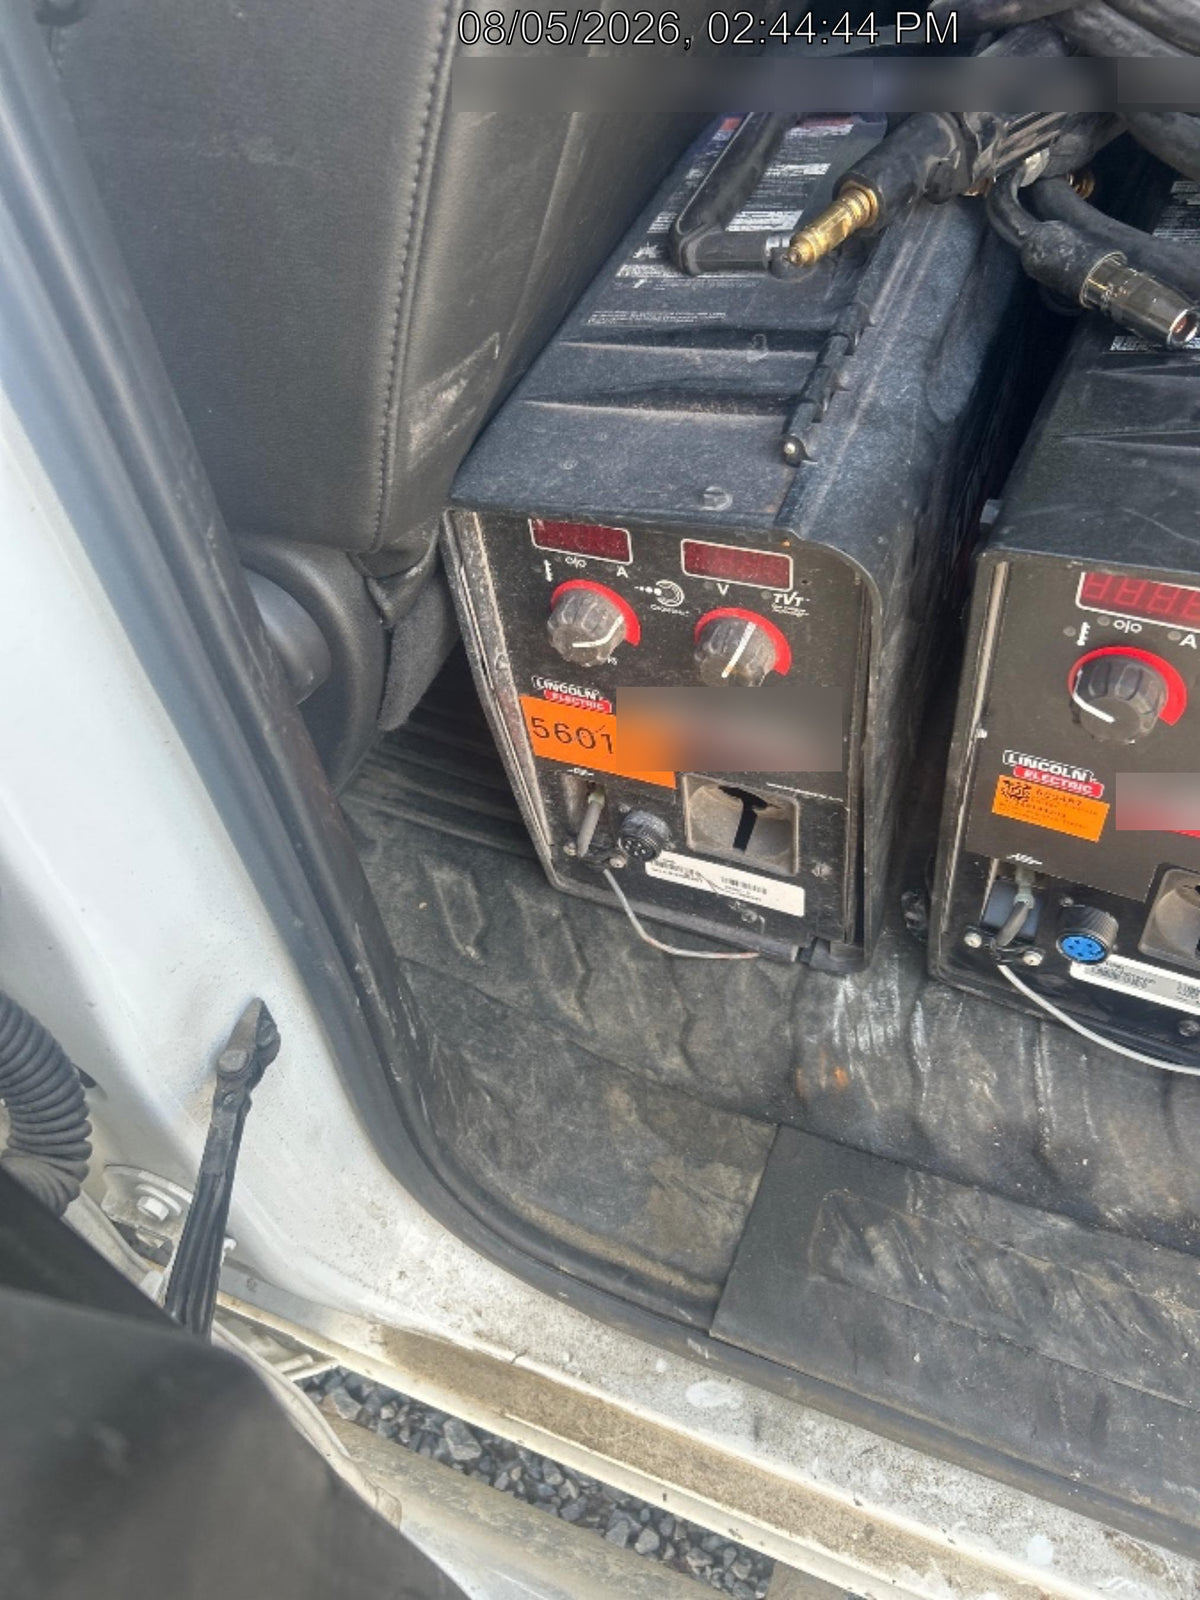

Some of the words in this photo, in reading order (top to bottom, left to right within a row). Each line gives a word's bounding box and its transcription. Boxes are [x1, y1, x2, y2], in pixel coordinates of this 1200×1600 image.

[616, 566, 629, 579] A
[716, 583, 730, 596] V
[1178, 633, 1198, 650] A
[530, 716, 614, 755] 5601
[1007, 752, 1089, 783] LINCOLN
[1022, 769, 1095, 796] ELECTRIC
